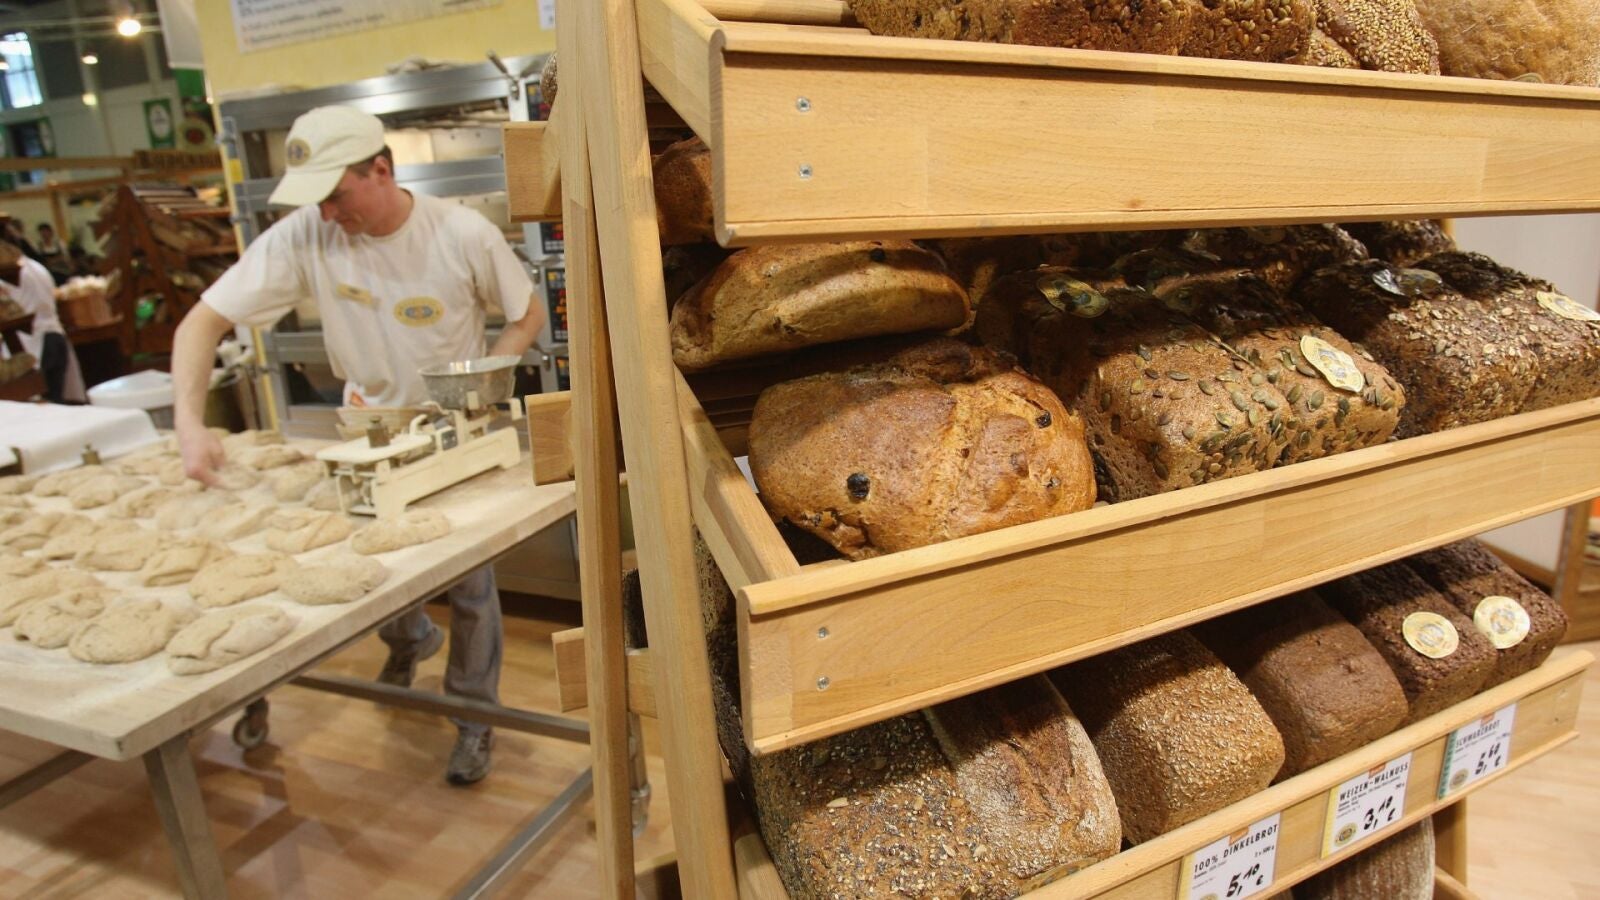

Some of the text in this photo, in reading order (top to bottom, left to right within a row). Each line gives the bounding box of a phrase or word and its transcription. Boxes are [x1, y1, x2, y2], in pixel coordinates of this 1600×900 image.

[1456, 720, 1500, 747] SCHWARZBROT
[1340, 763, 1408, 800] WEIZEN-WALNUSS
[1194, 854, 1219, 873] 100%
[1223, 824, 1278, 858] DINKELBROT
